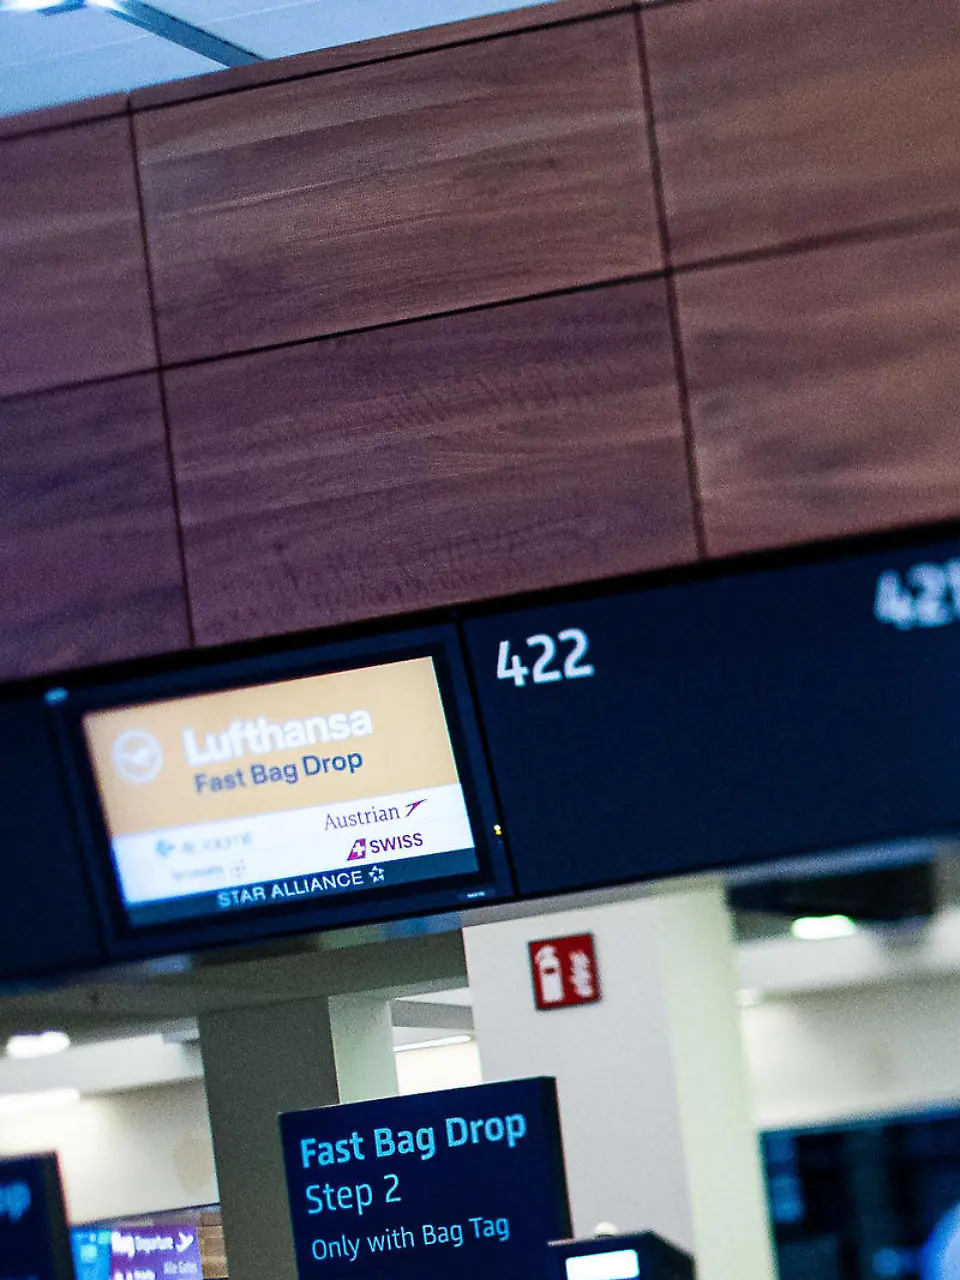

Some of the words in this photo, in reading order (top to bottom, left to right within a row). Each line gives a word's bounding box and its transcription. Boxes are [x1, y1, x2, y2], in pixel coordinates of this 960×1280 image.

[497, 628, 595, 686] 422
[183, 708, 374, 767] Lufthansa
[194, 765, 246, 795] Fast
[250, 758, 299, 786] Bag
[304, 750, 363, 777] Drop
[324, 804, 401, 831] Austrian
[368, 832, 423, 855] SWISS
[215, 885, 266, 909] STAR
[270, 868, 364, 900] ALLIANCE
[301, 1131, 365, 1168] Fast
[374, 1126, 436, 1161] Bag
[446, 1113, 527, 1148] Drop
[306, 1182, 373, 1215] Step
[384, 1173, 402, 1203] 2
[311, 1235, 360, 1262] Only
[367, 1226, 415, 1253] with
[422, 1223, 464, 1248] Bag
[469, 1216, 510, 1242] Tag
